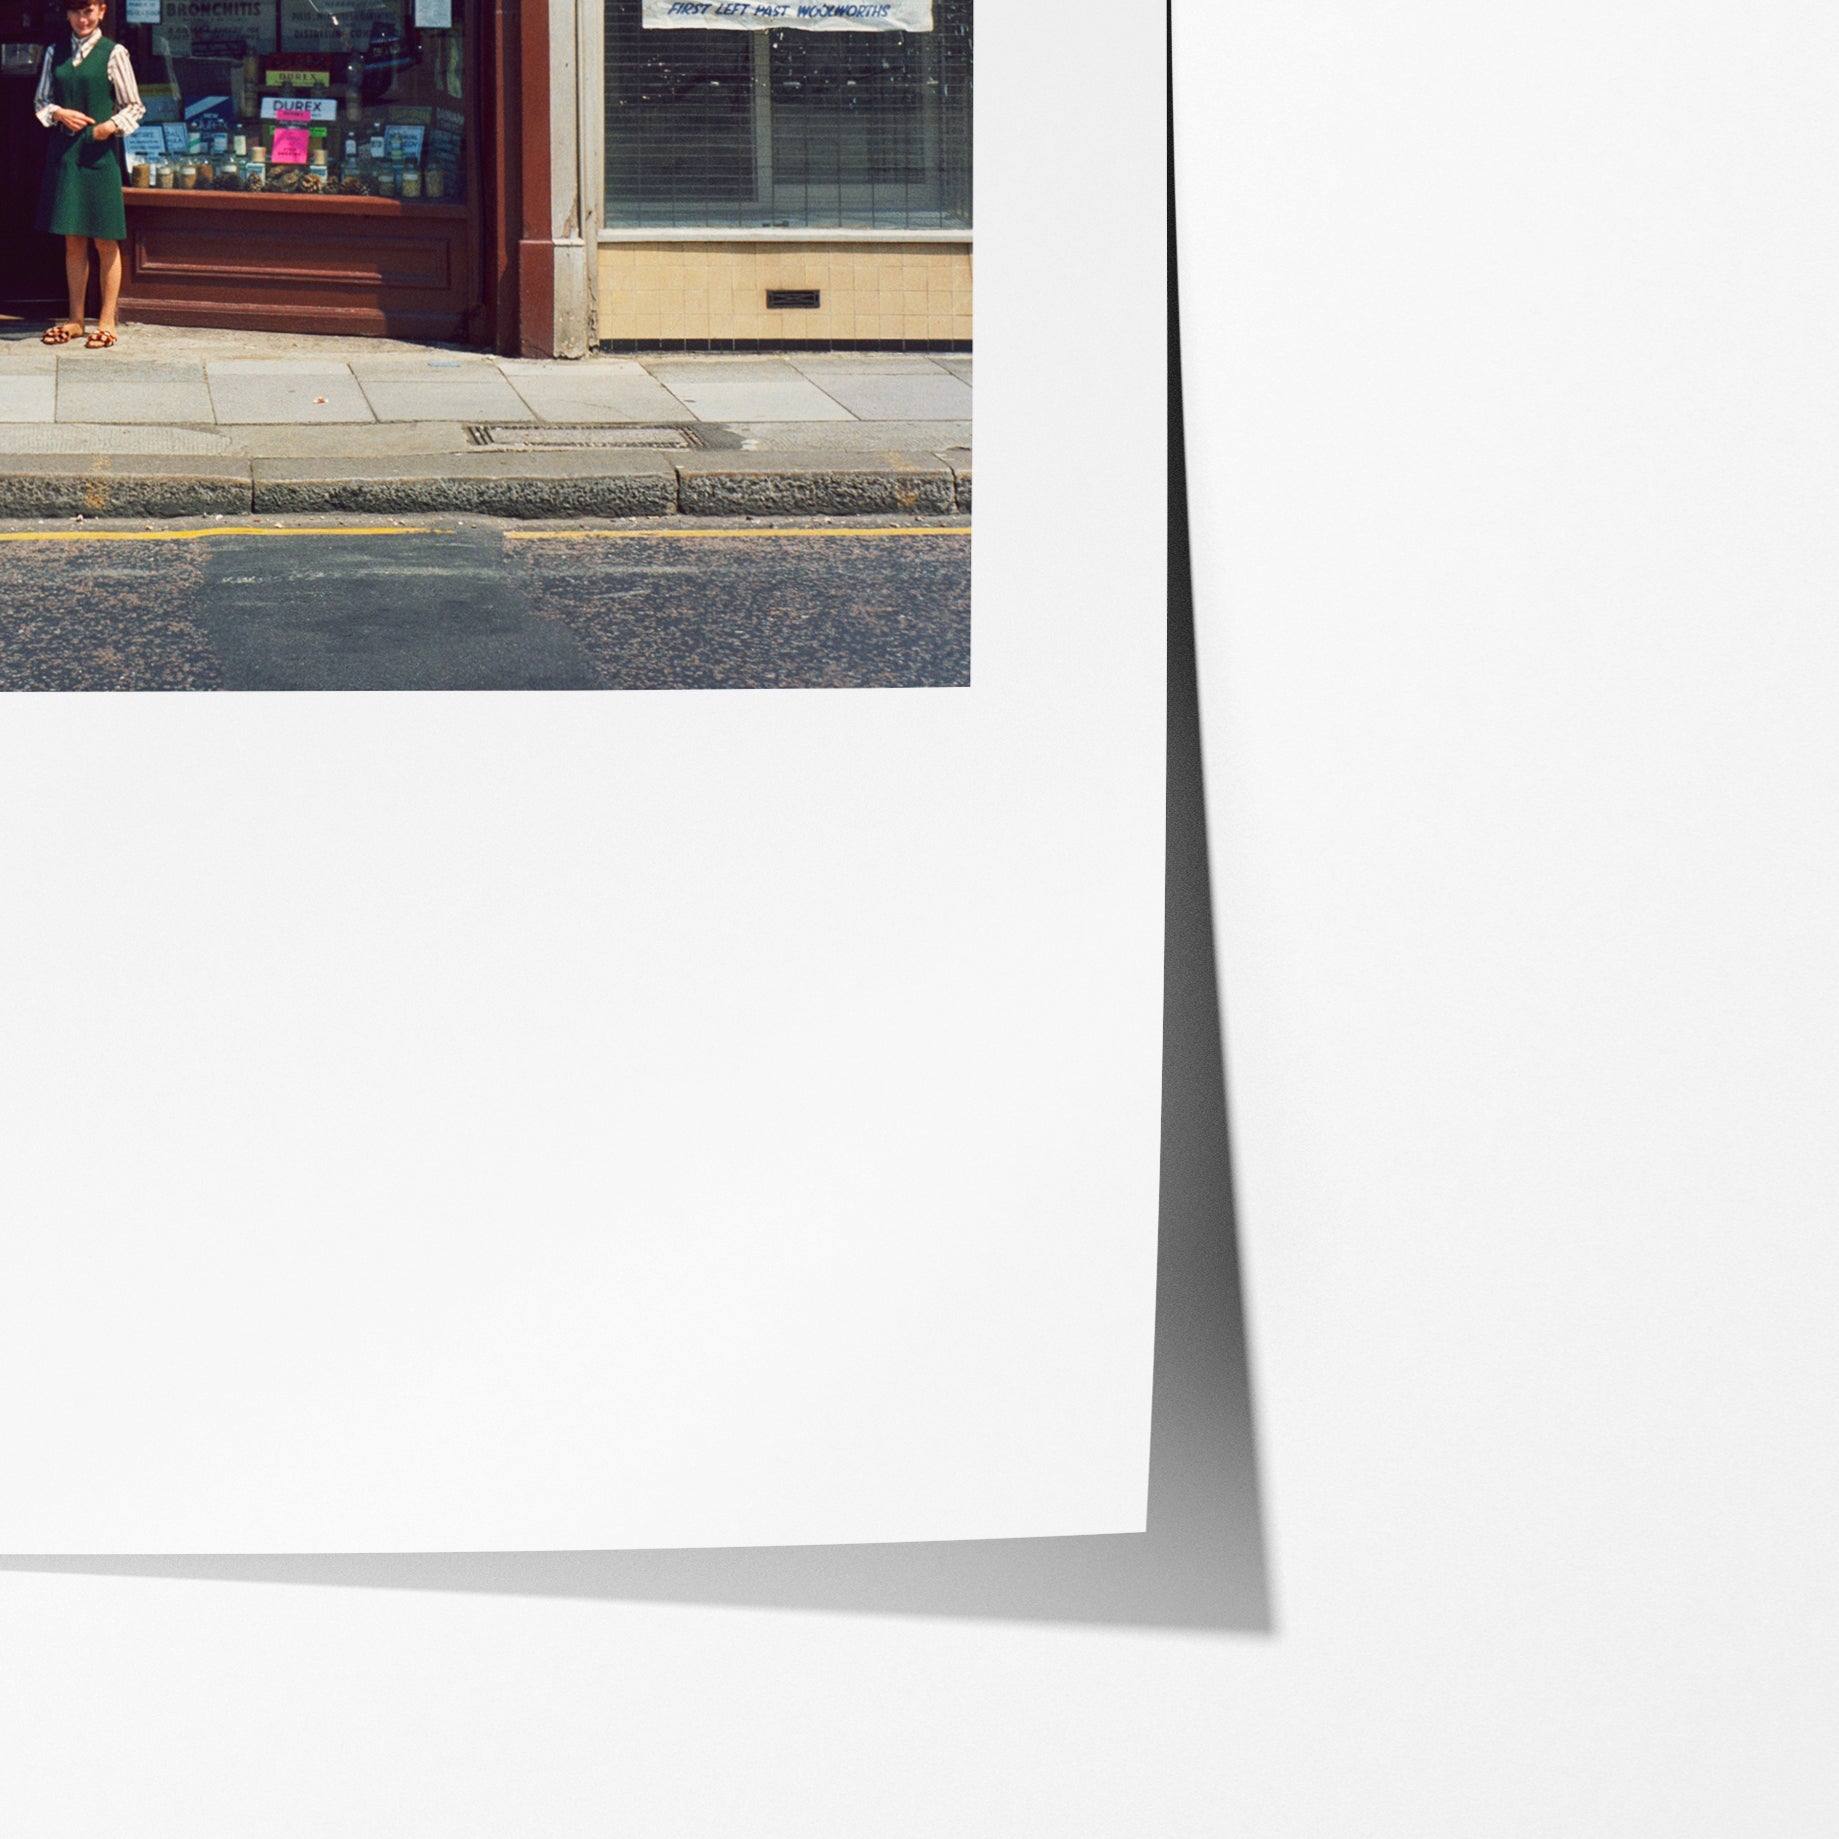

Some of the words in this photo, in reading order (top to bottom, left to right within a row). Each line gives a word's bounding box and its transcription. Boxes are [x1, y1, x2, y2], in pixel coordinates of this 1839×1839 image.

[166, 2, 261, 17] BRONCHITIS
[667, 3, 712, 15] FIRST
[715, 3, 750, 15] LEFT
[754, 4, 789, 16] PAST
[797, 4, 890, 17] WOOLWORTHS
[273, 100, 322, 112] DUREX
